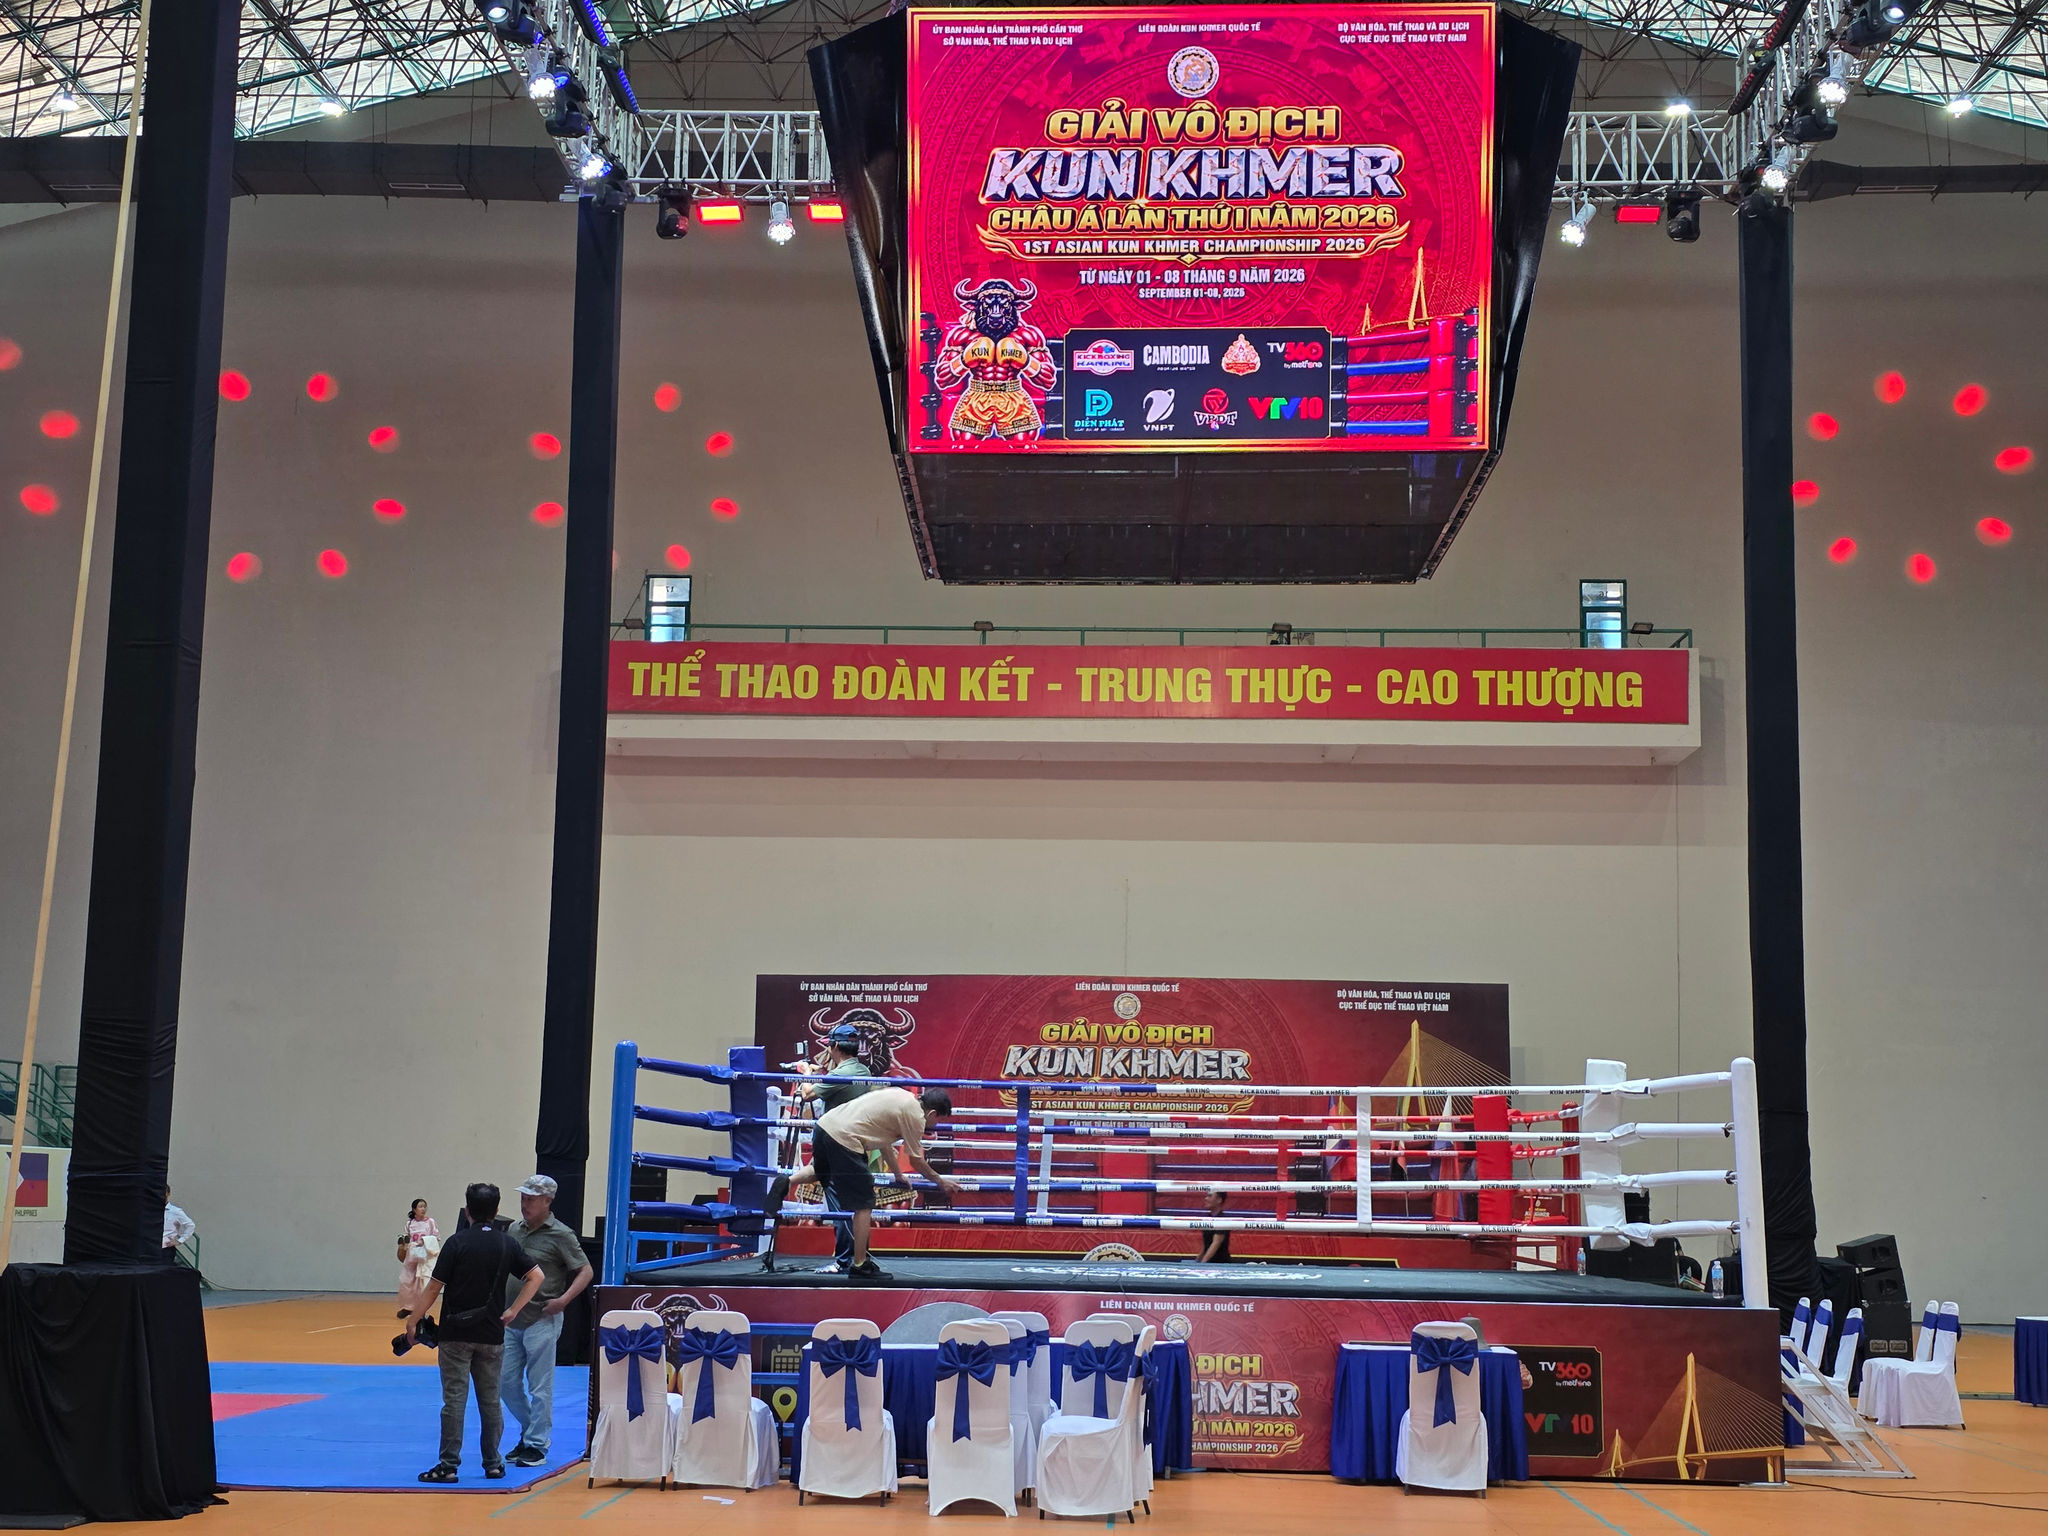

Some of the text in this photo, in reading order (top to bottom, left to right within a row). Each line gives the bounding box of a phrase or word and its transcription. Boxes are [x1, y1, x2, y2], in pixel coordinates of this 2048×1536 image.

[1048, 99, 1340, 146] GIẢI VÔ ĐỊCH
[984, 147, 1404, 200] KUN KHMER
[991, 200, 1396, 231] CHÂU Á LẦN THỨ I NĂM 2026
[1024, 238, 1366, 254] 1ST ASIAN KUN KHMER CHAMPIONSHIP 2026
[1079, 267, 1306, 285] TỪ NGÀY 01 08 THÁNG 9 NĂM 2026
[1138, 288, 1192, 299] SEPTEMBER
[1223, 288, 1245, 298] 2026
[971, 348, 990, 357] KUN
[1143, 344, 1210, 367] CAMBODIA
[628, 648, 1644, 715] THỂ THAO ĐOÀN KẾT - TRUNG THỰC - CAO THƯỢNG
[1075, 982, 1091, 991] LIÊN
[1127, 984, 1151, 992] KHMER
[1172, 982, 1180, 992] TẾ
[1395, 991, 1413, 999] THAO
[1414, 991, 1423, 1000] VÀ
[1398, 1002, 1415, 1011] THAO
[1432, 1004, 1449, 1012] NAM
[1042, 1018, 1213, 1048] GIẢI VÔ ĐỊCH
[1003, 1046, 1251, 1080] KUN KHMER
[1031, 1101, 1229, 1112] ST ASIAN KUN KHMER CHAMPIONSHIP 2026
[1100, 1299, 1255, 1313] LIÊN ĐOÀN KUN KHMER QUỐC TẾ
[1196, 1354, 1262, 1379] ĐỊCH
[1192, 1381, 1300, 1417] HMER
[1211, 1418, 1251, 1436] NĂM
[1254, 1422, 1296, 1438] 2026
[1255, 1443, 1279, 1453] 2026
